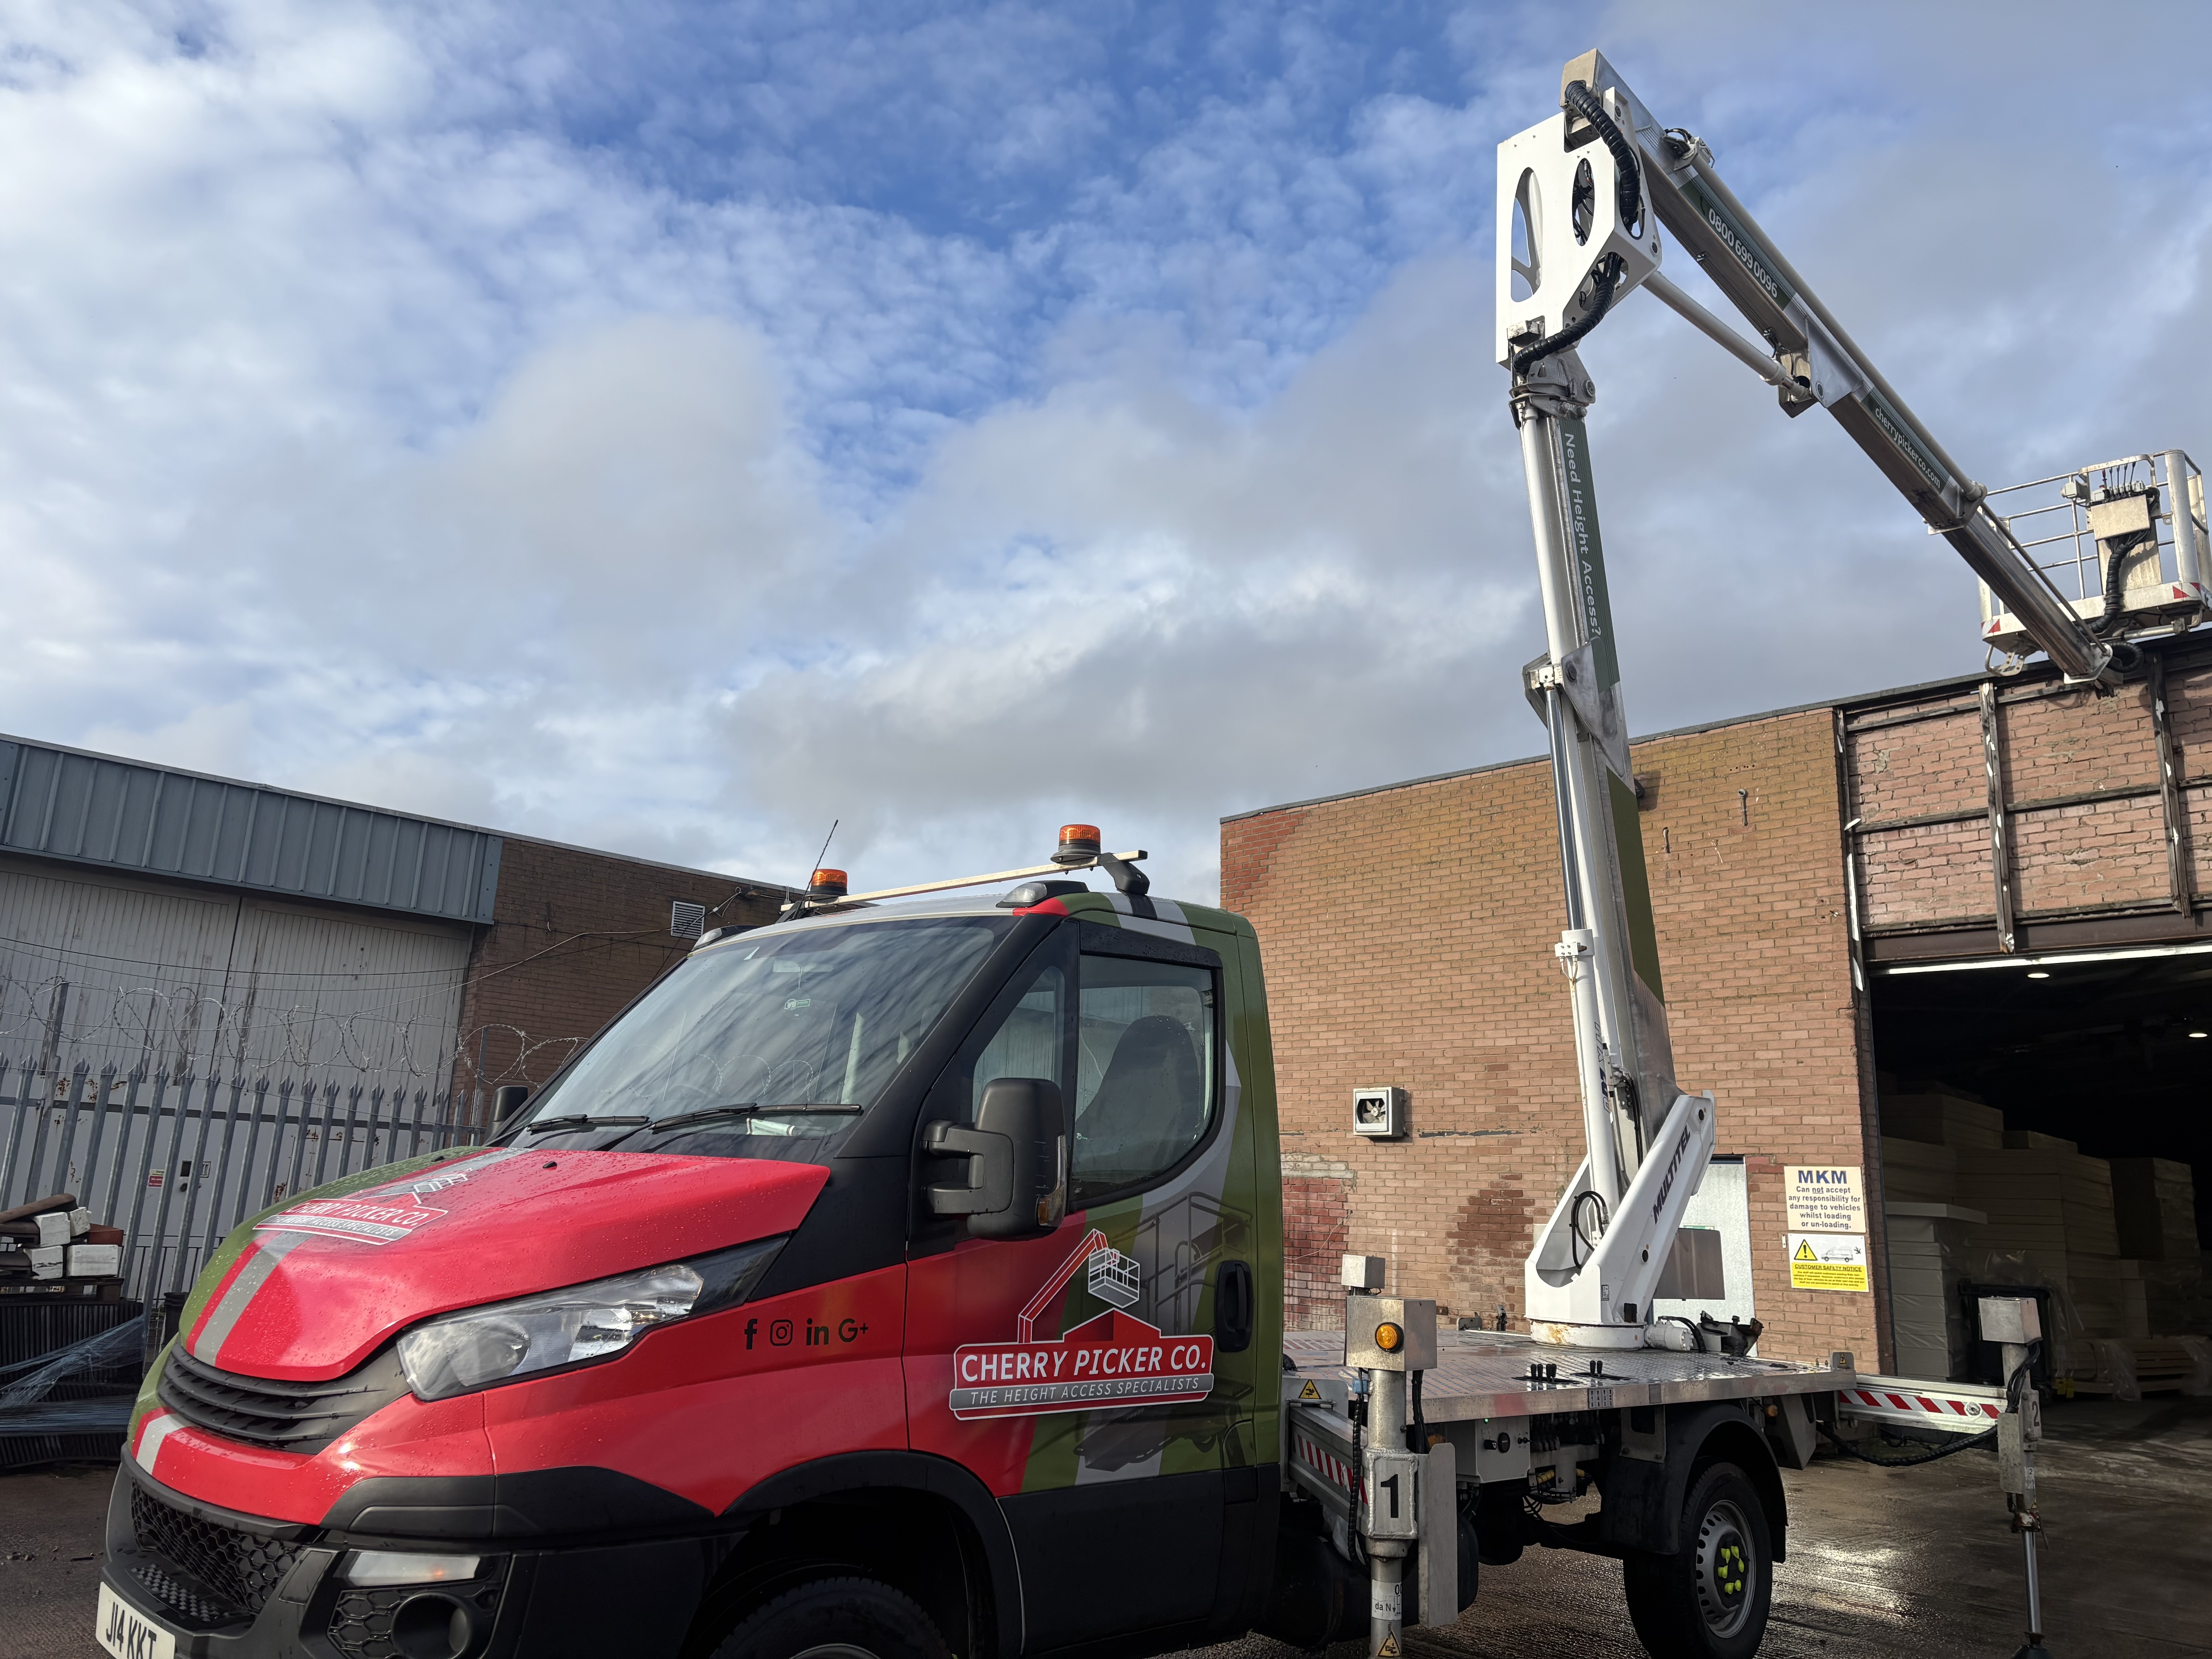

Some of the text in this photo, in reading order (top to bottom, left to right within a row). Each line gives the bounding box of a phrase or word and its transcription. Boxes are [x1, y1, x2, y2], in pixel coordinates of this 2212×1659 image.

[1709, 208, 1778, 298] 0800 699 0096
[1875, 407, 1941, 488] cherrypickerco.com
[1565, 433, 1601, 636] Need Height Access?
[1653, 1124, 1691, 1225] MULTITEL
[1798, 1170, 1847, 1184] MKM
[1790, 1203, 1818, 1211] damage
[1802, 1195, 1849, 1203] responsibility
[285, 1202, 430, 1226] CHERRY PICKER CO.
[308, 1218, 344, 1227] ACCESS
[338, 1221, 399, 1236] SPECIALISTS
[1811, 1221, 1851, 1230] un-loading.
[1824, 1212, 1851, 1221] loading
[806, 1317, 829, 1346] in
[961, 1345, 1206, 1382] CHERRY PICKER CO.
[971, 1377, 1199, 1405] THE HEIGHT ACCESS SPECIALISTS
[2032, 1401, 2040, 1427] 2
[1380, 1474, 1399, 1518] 1
[106, 1601, 157, 1659] J14 KKT
